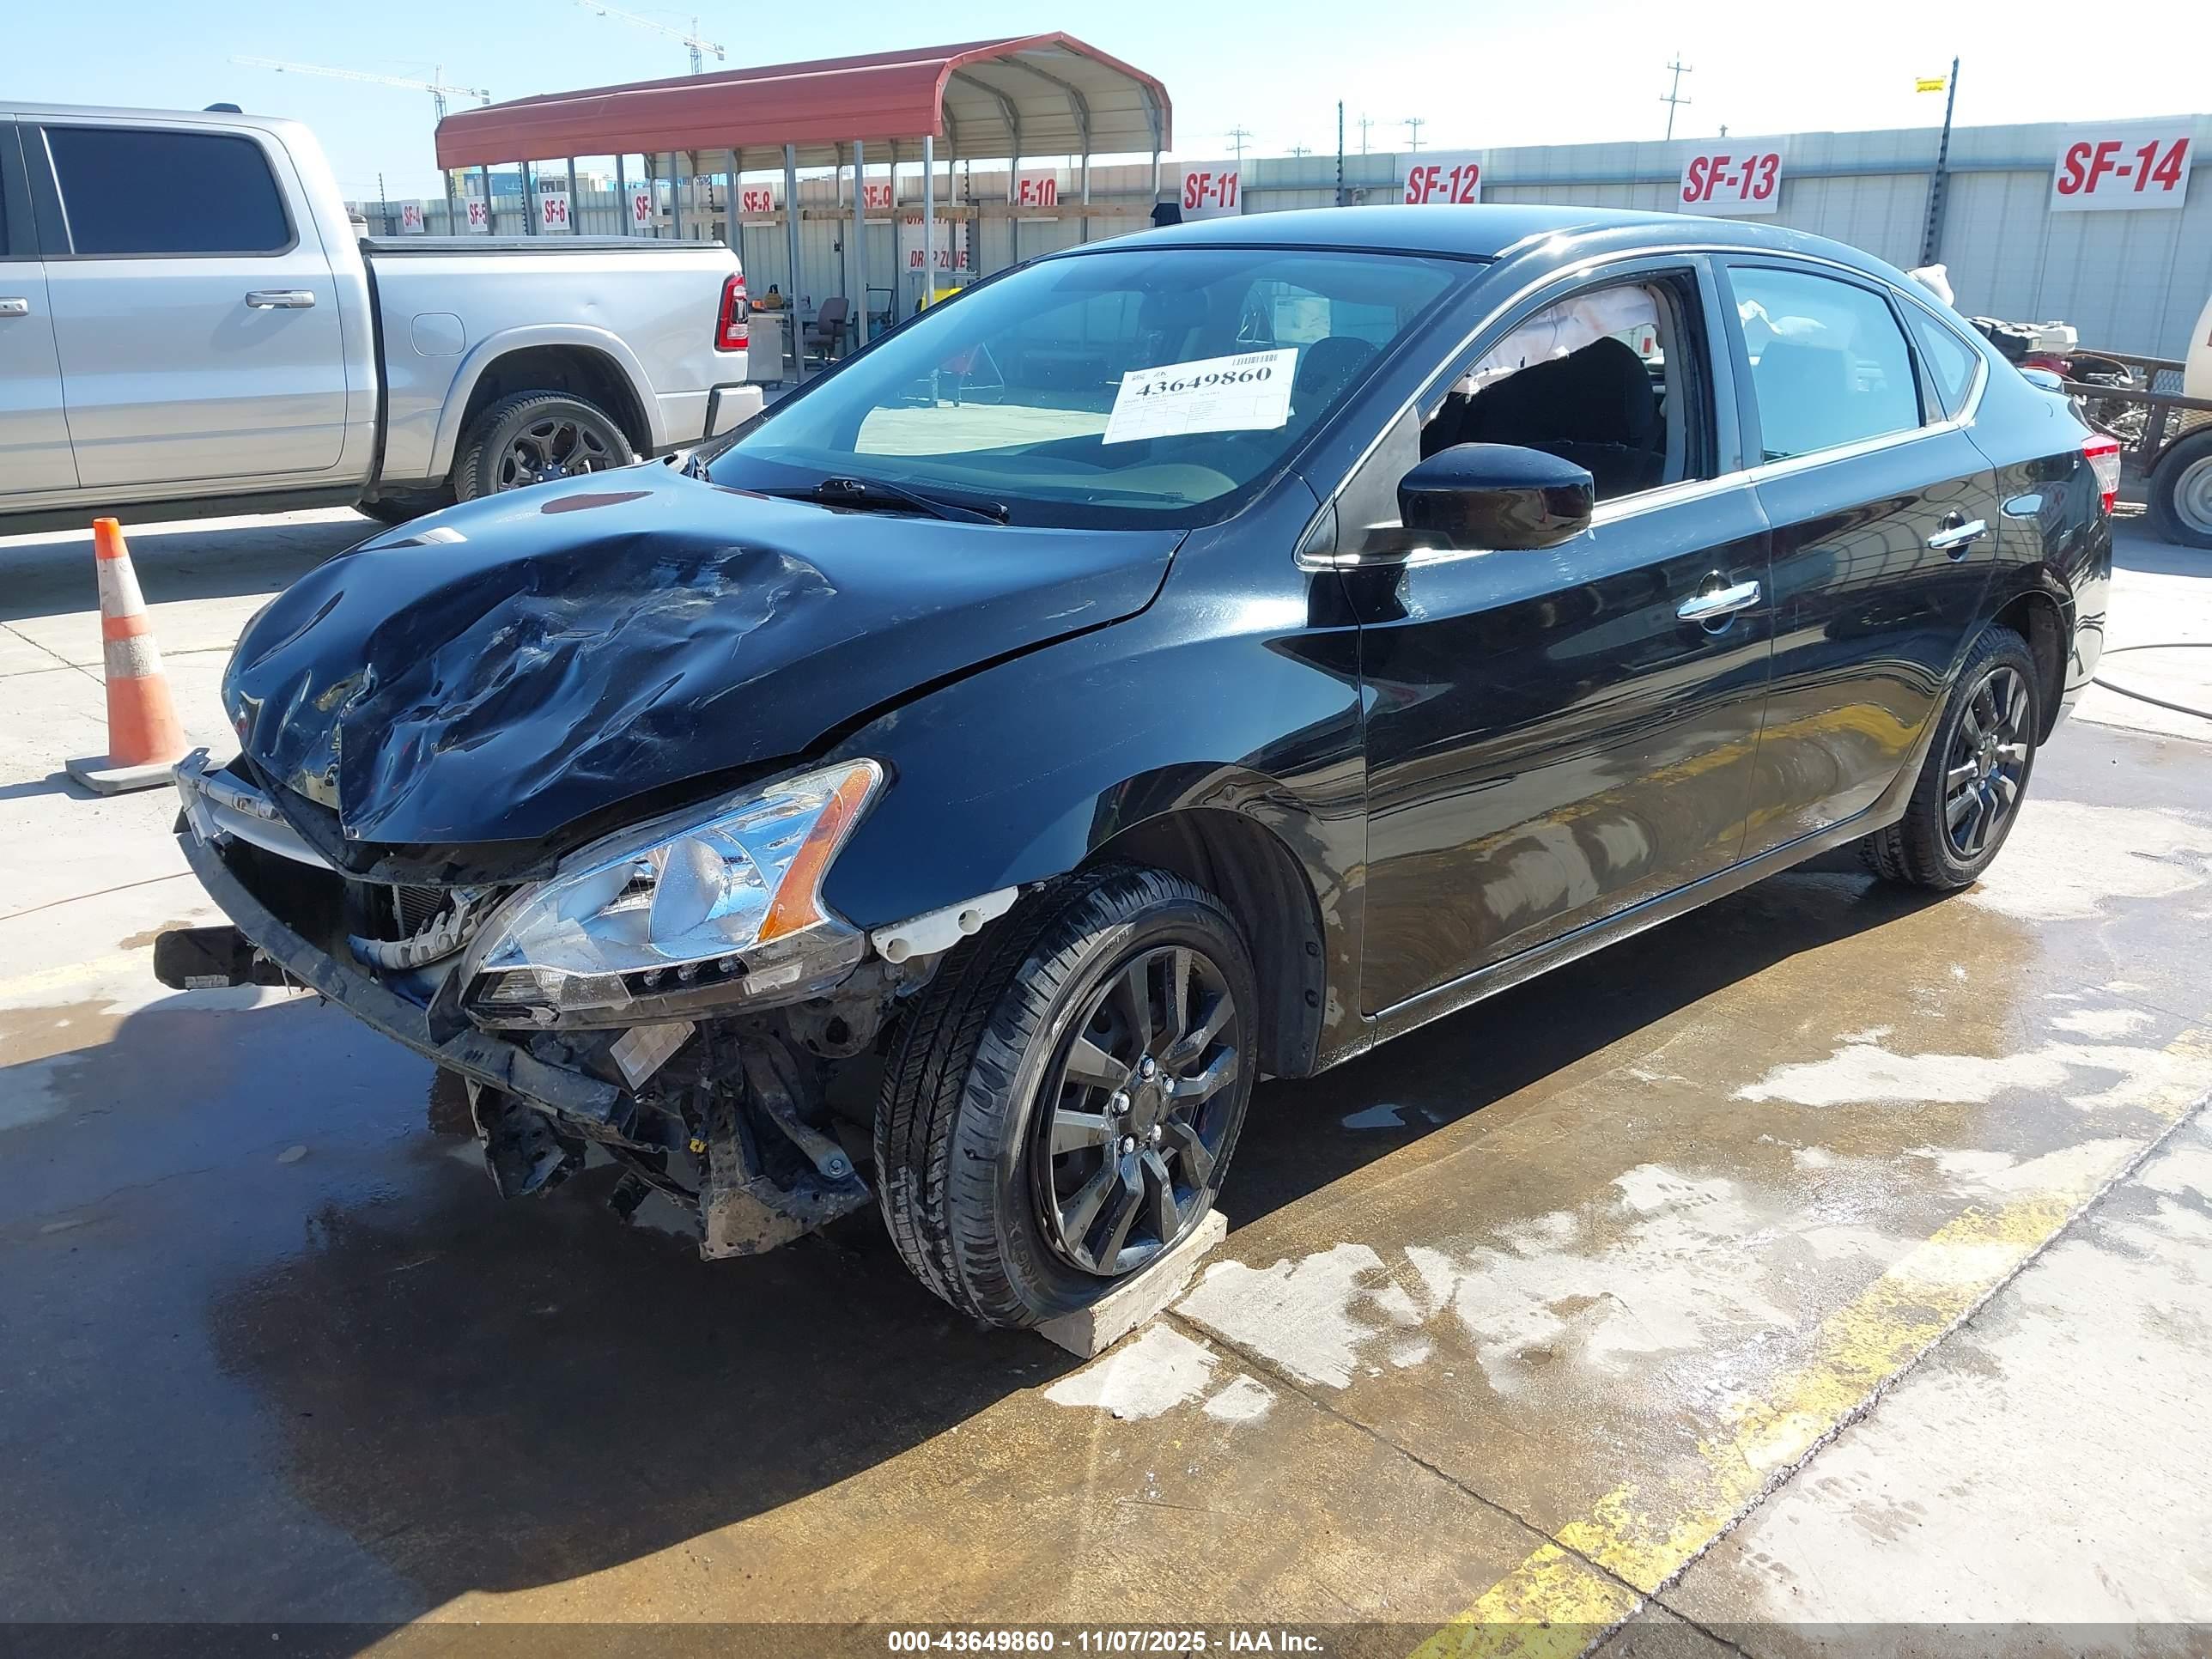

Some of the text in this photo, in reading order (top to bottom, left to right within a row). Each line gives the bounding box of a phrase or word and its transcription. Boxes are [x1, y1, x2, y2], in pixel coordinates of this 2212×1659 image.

[1683, 154, 1779, 202] SF-13
[2057, 138, 2190, 195] SF-14
[1185, 172, 1237, 210] SF-11
[1406, 164, 1479, 204] SF-12
[404, 206, 421, 227] SF-4
[545, 199, 565, 222] SF-6
[744, 191, 769, 212] SF-8
[1136, 368, 1272, 396] 43649860
